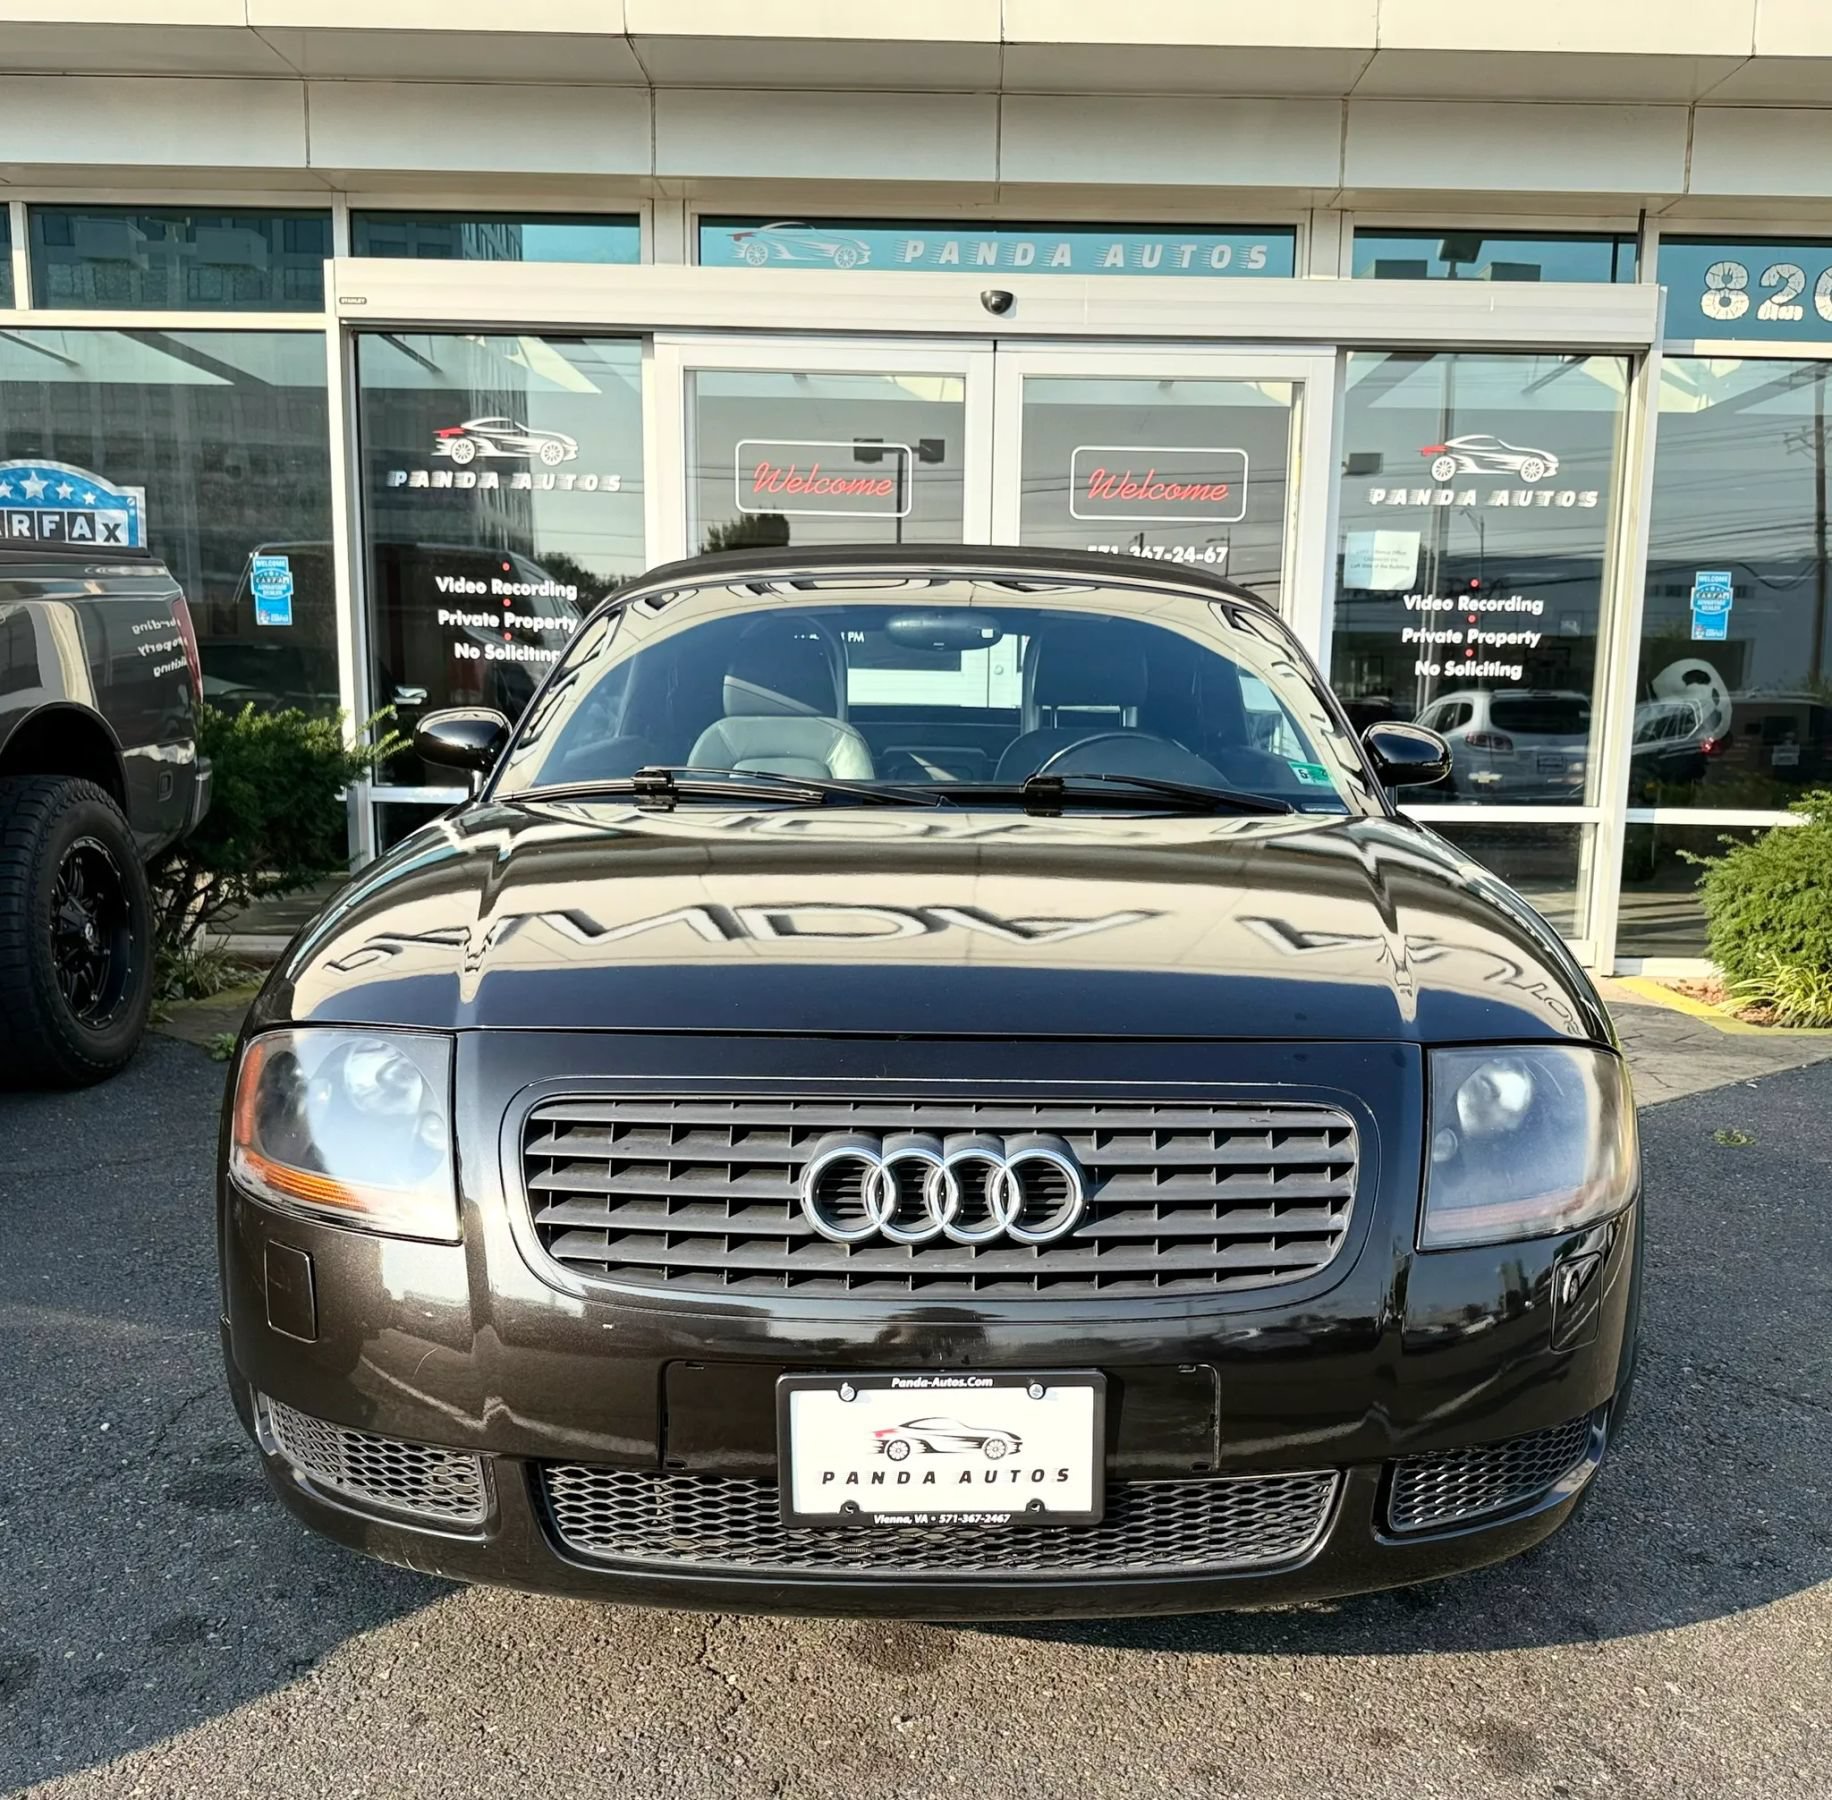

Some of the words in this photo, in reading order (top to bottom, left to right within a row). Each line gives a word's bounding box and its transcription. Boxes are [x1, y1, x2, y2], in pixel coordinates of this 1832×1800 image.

[898, 240, 1072, 267] PANDA
[1096, 244, 1268, 270] AUTOS
[388, 470, 499, 489] PANDA
[511, 472, 621, 491] AUTOS
[751, 462, 894, 498] Welcome
[1086, 468, 1230, 502] Welcome
[1369, 488, 1477, 506] PANDA
[1489, 490, 1598, 508] AUTOS
[0, 513, 121, 543] RFAX
[435, 576, 487, 594] Video
[491, 578, 577, 601] Recording
[1403, 594, 1454, 611] Video
[1458, 595, 1544, 616] Recording
[437, 609, 500, 627] Private
[503, 611, 578, 634] Property
[1402, 627, 1463, 644] Private
[1467, 628, 1542, 648] Property
[454, 642, 481, 660] No
[1414, 660, 1441, 677] No
[1444, 660, 1523, 680] Soliciting
[891, 1376, 993, 1388] Panda-Autos.Com
[822, 1470, 937, 1485] PANDA
[958, 1468, 1070, 1484] AUTOS
[873, 1514, 912, 1524] Vienna,
[914, 1514, 929, 1524] VA
[938, 1514, 1011, 1524] 571-367-2467
